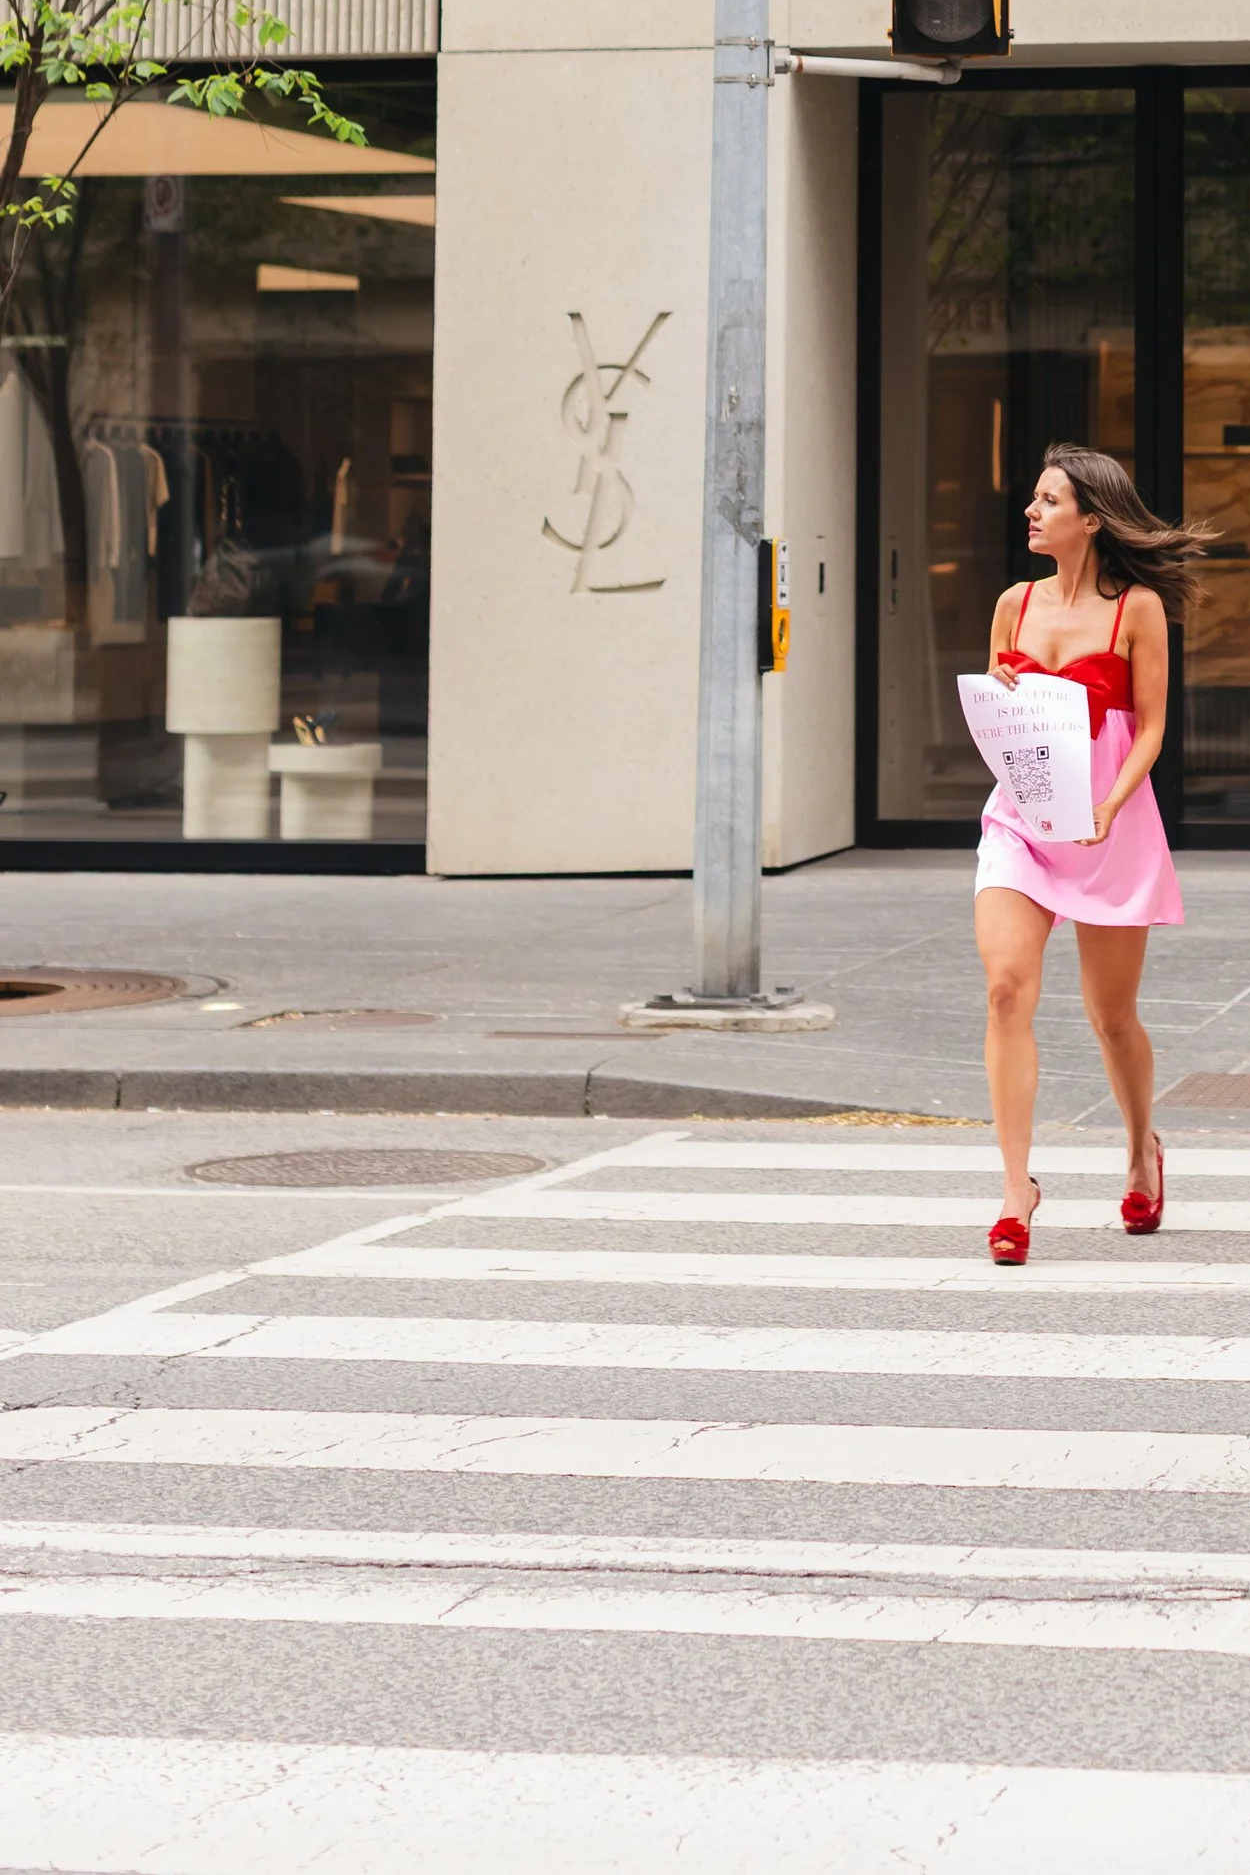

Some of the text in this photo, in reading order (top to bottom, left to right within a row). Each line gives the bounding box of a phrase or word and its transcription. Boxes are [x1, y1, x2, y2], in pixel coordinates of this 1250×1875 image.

[1016, 690, 1071, 702] ULTURE
[997, 705, 1047, 718] IS DEAD
[1006, 723, 1029, 736] THE
[1032, 721, 1085, 733] KILLERS
